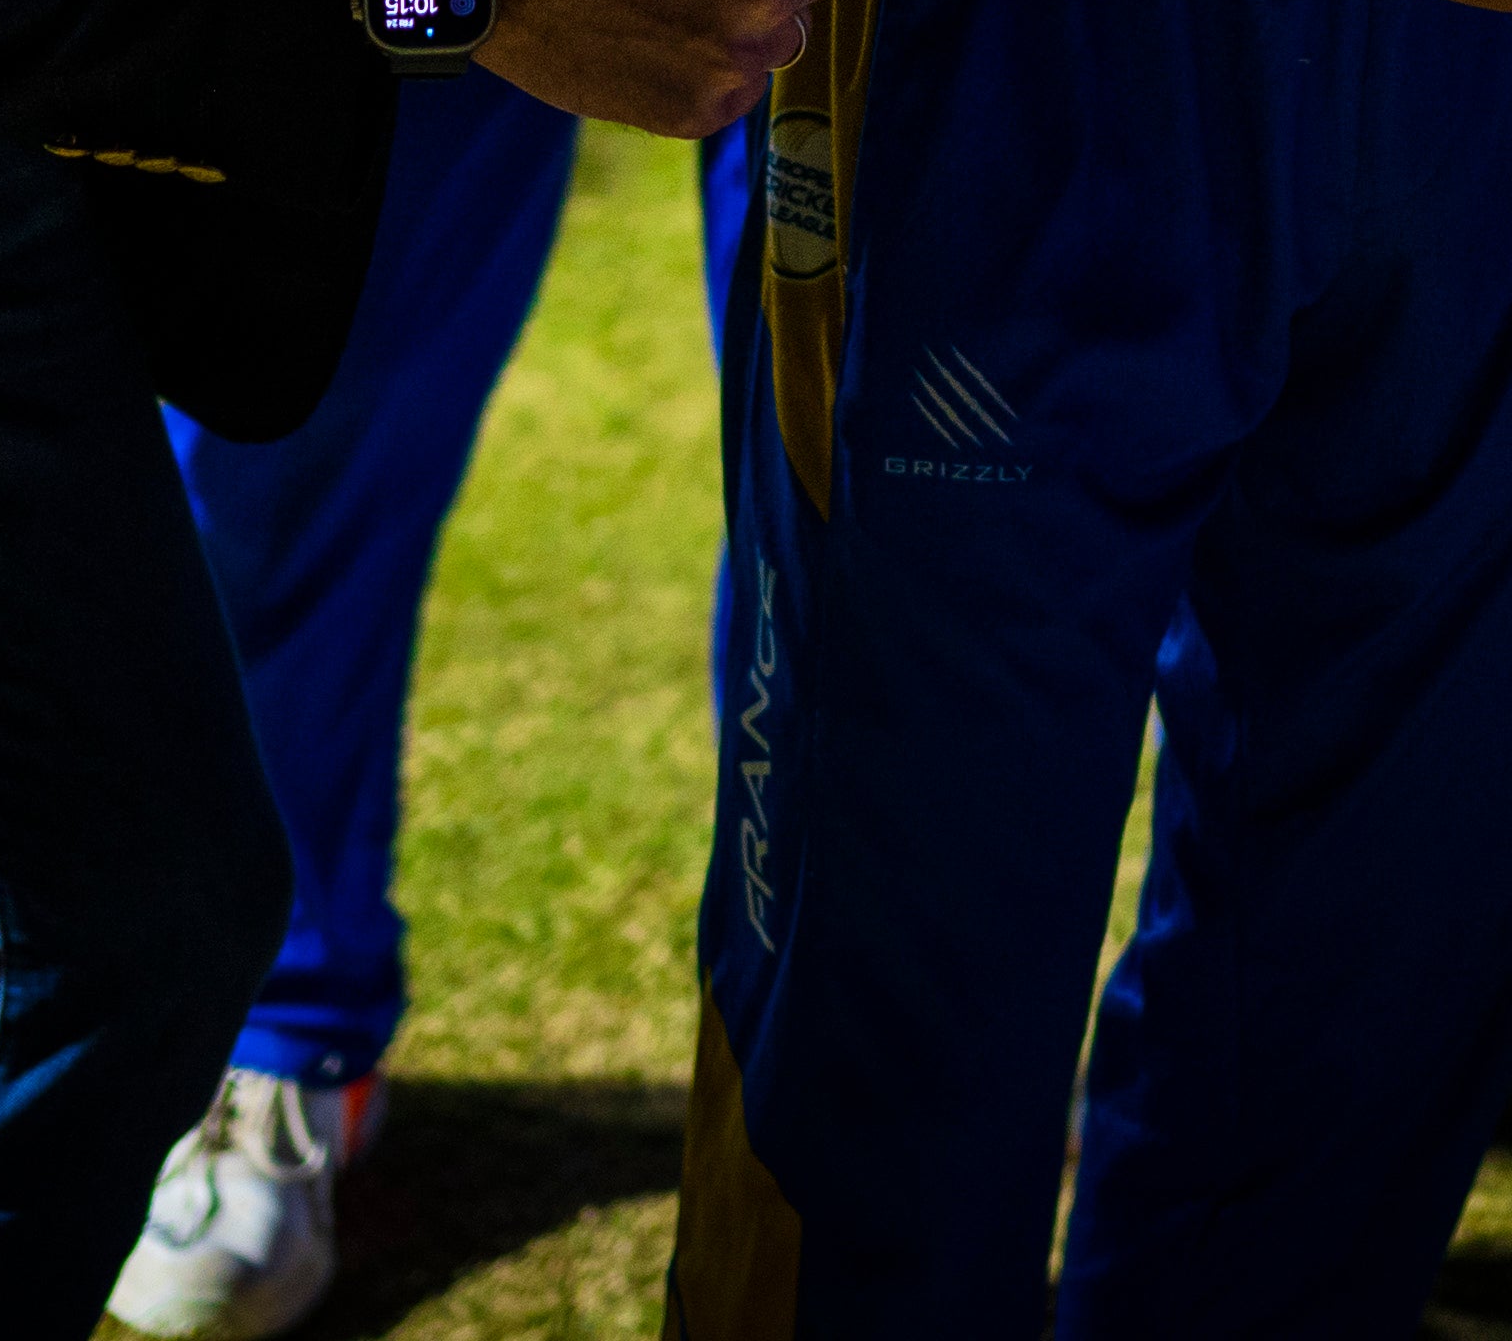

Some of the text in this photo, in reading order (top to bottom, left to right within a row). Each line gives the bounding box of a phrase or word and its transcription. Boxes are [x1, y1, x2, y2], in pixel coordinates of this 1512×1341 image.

[386, 18, 414, 29] FRI 24
[885, 457, 1032, 481] GRIZZLY
[739, 554, 777, 954] FRANCE
